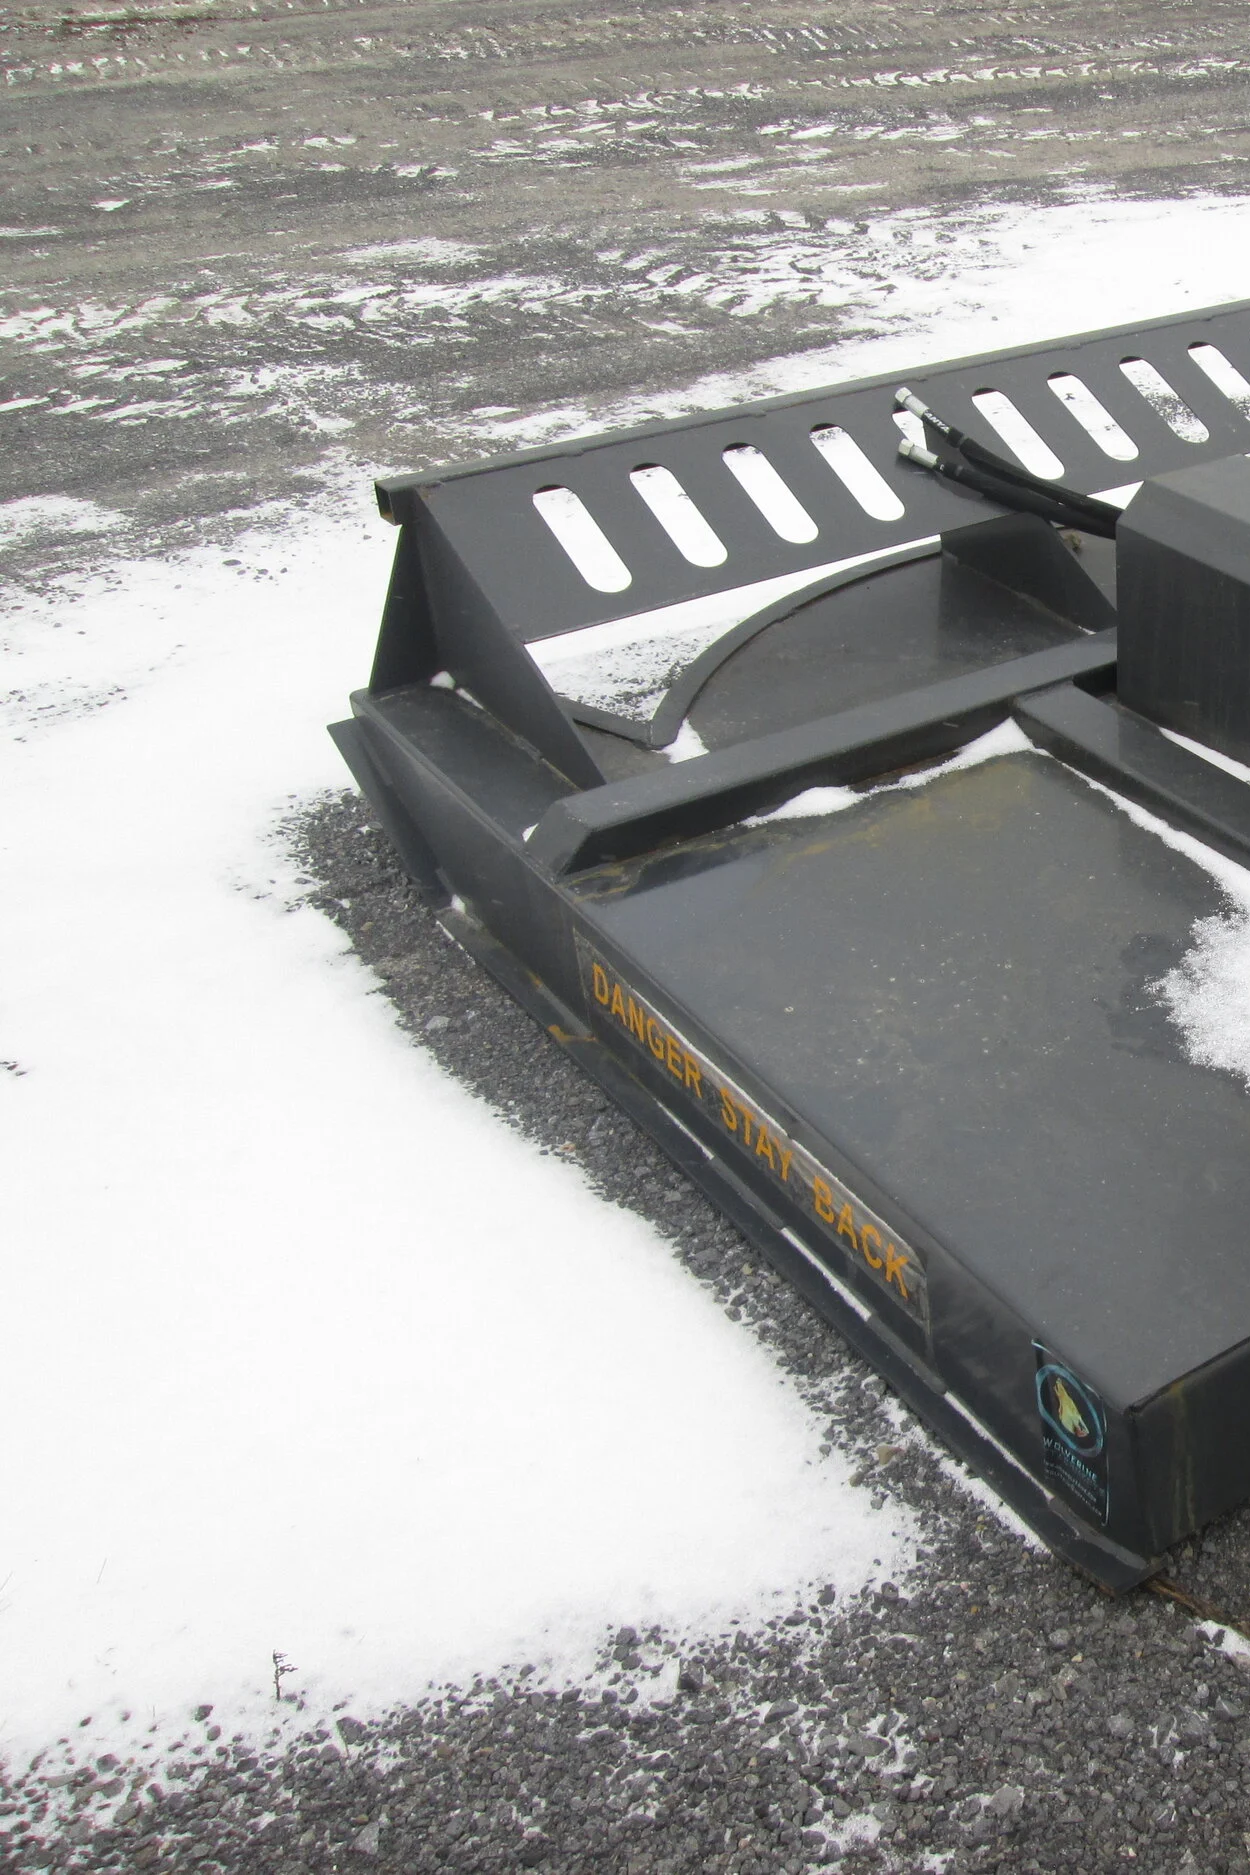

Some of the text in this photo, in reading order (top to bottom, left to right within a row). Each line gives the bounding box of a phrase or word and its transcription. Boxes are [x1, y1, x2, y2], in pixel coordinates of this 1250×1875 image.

[592, 962, 909, 1300] DANGER STAY BACK
[1043, 1437, 1098, 1481] WOLVERINE
